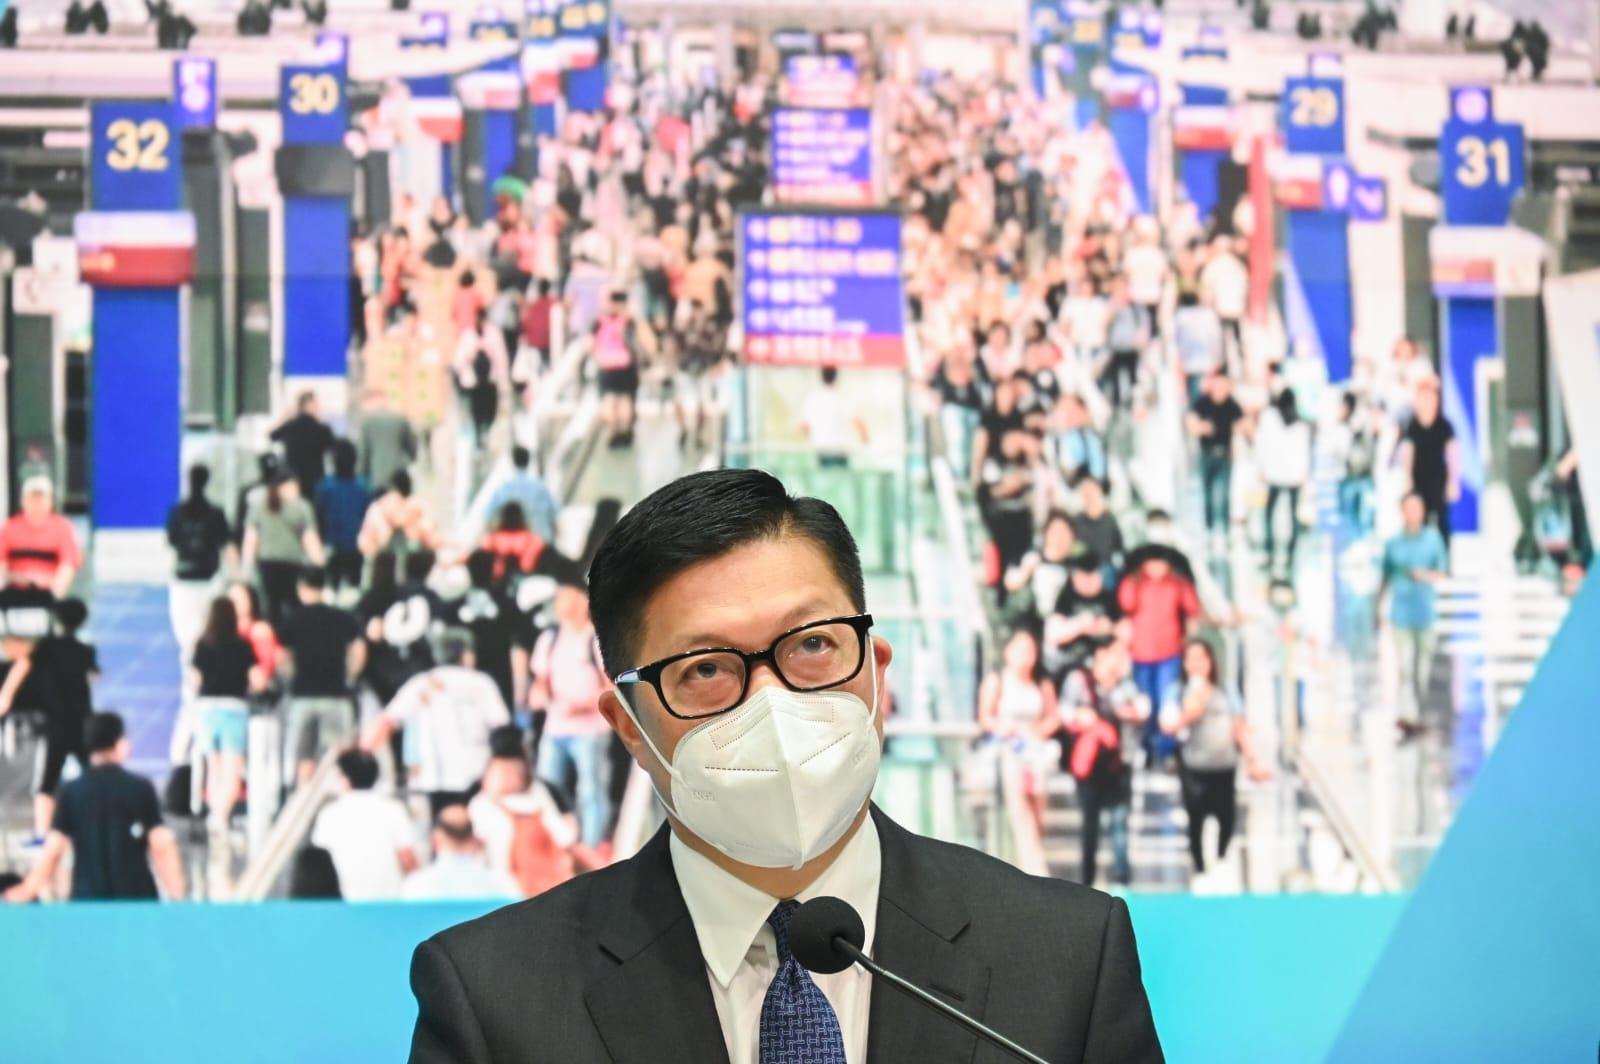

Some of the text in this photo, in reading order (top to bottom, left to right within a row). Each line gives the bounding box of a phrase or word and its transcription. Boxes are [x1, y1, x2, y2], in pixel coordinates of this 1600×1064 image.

[290, 73, 340, 115] 30
[1290, 85, 1340, 128] 29
[106, 118, 170, 172] 32
[1456, 136, 1510, 189] 31
